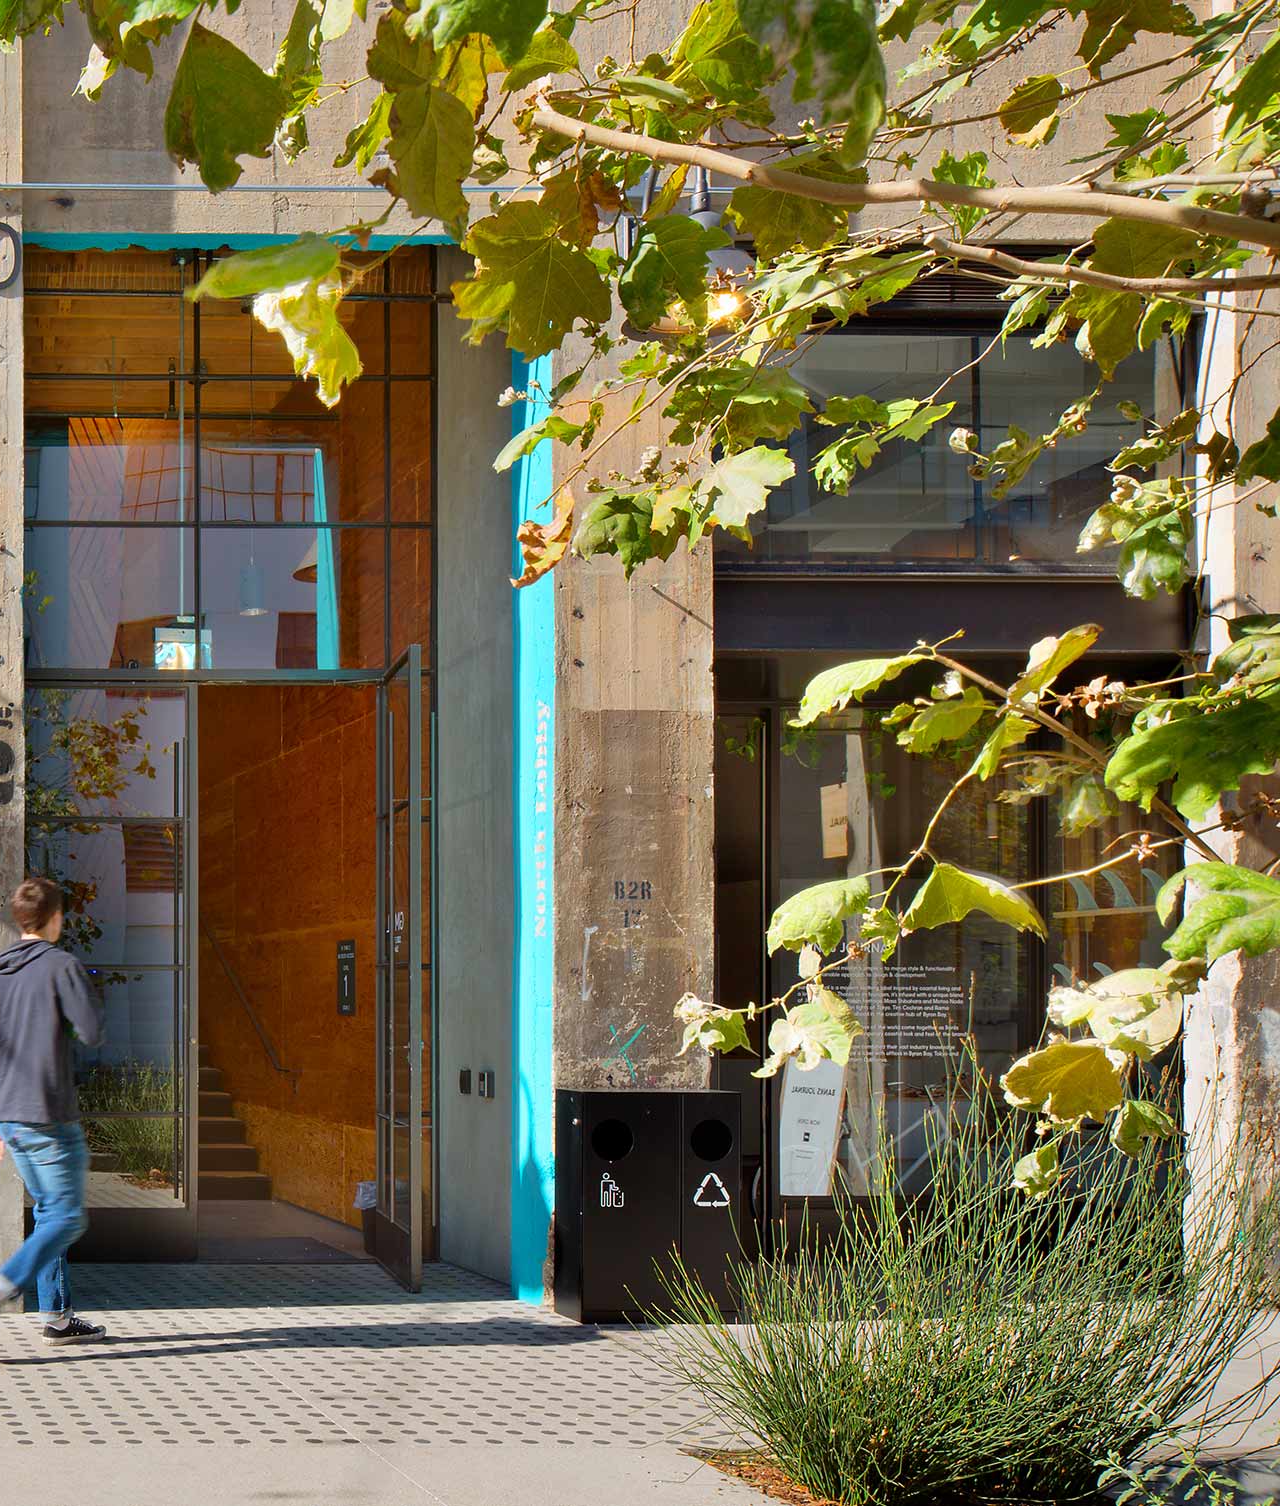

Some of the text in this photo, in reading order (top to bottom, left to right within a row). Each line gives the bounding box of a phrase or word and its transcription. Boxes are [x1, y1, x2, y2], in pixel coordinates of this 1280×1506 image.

[534, 701, 551, 937] North Lobby
[614, 879, 652, 900] B2R
